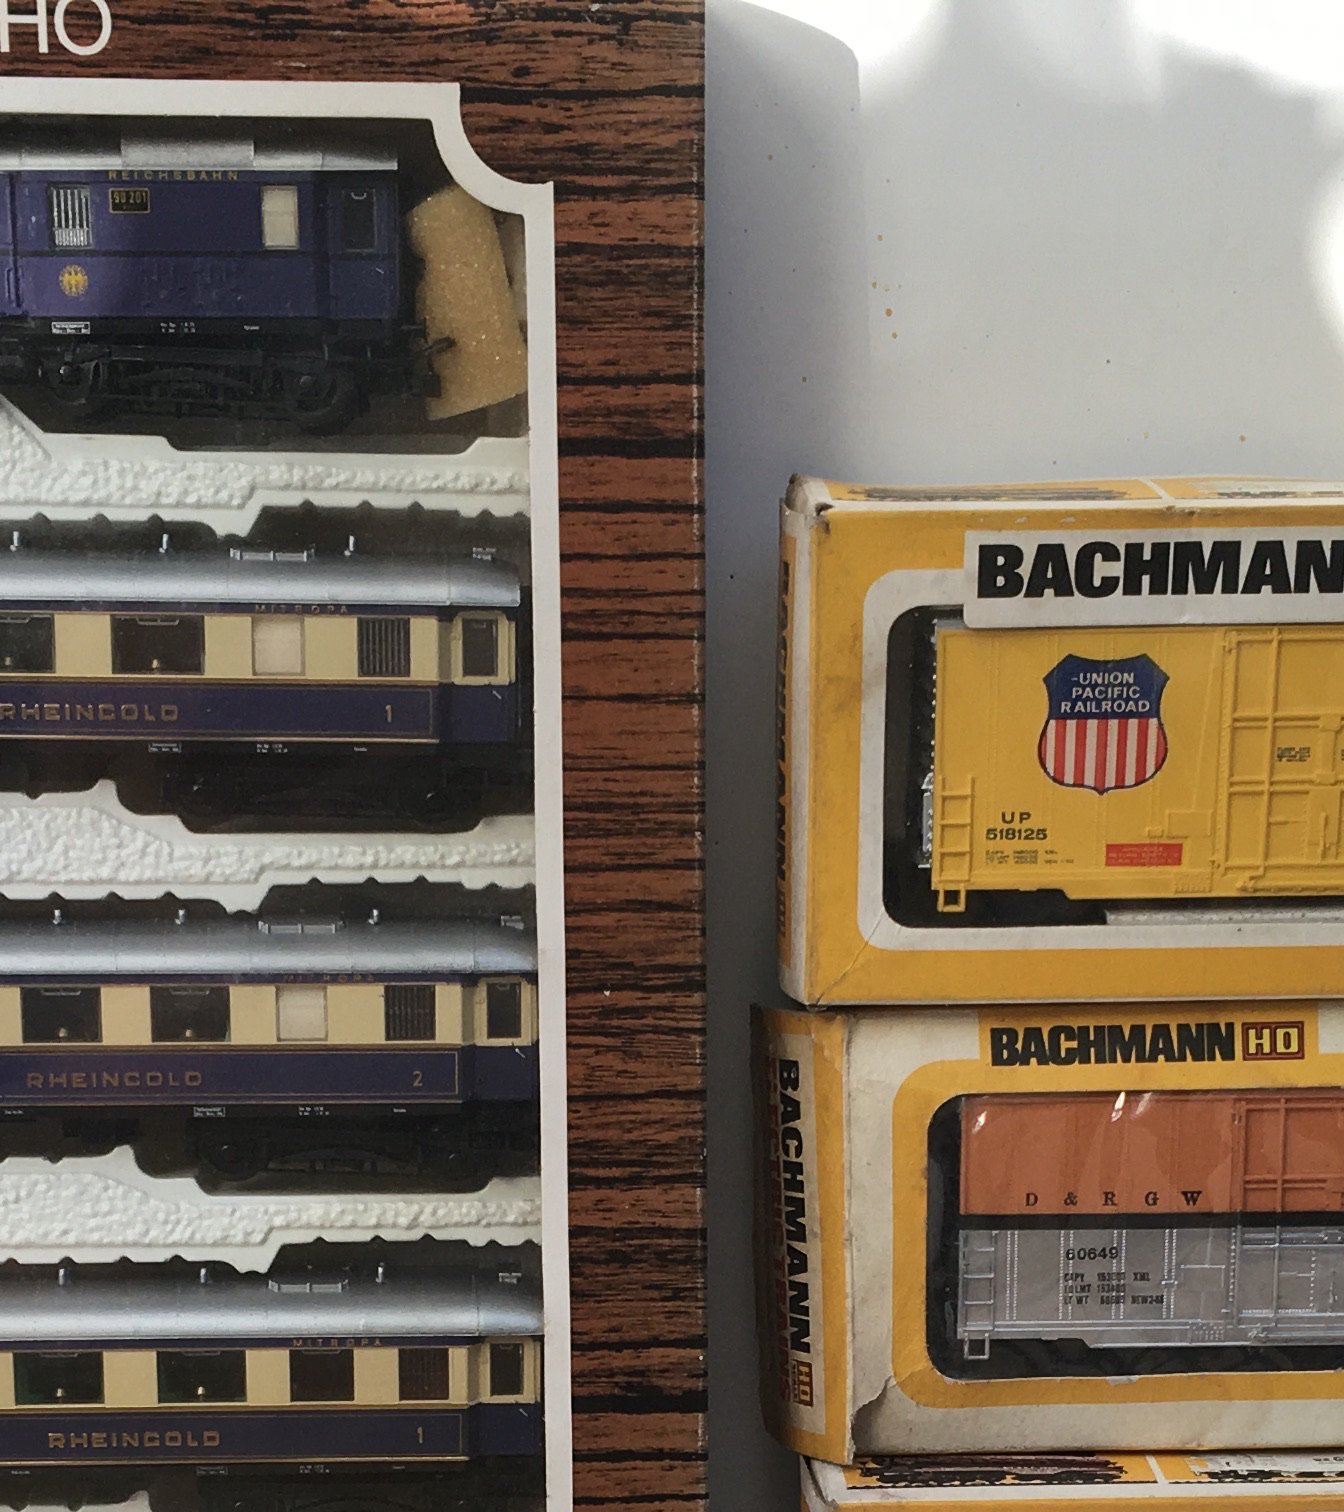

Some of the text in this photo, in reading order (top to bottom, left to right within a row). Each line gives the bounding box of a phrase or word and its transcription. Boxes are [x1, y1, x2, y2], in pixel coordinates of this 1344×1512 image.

[0, 0, 112, 56] HO
[108, 170, 239, 181] REICHSBAHN
[1078, 672, 1135, 685] UNION
[1071, 685, 1141, 699] PACIFIC
[1060, 700, 1151, 714] RAILROAD
[985, 828, 1049, 841] 518125
[989, 1022, 1300, 1067] BACHMANN HO
[25, 1070, 203, 1089] RHEINGOLD
[411, 1071, 424, 1087] 2
[776, 1058, 812, 1354] BACHMANN
[1024, 1190, 1203, 1207] D & R G W
[1065, 1246, 1119, 1261] 60649
[48, 1430, 221, 1449] RHEINGOLD
